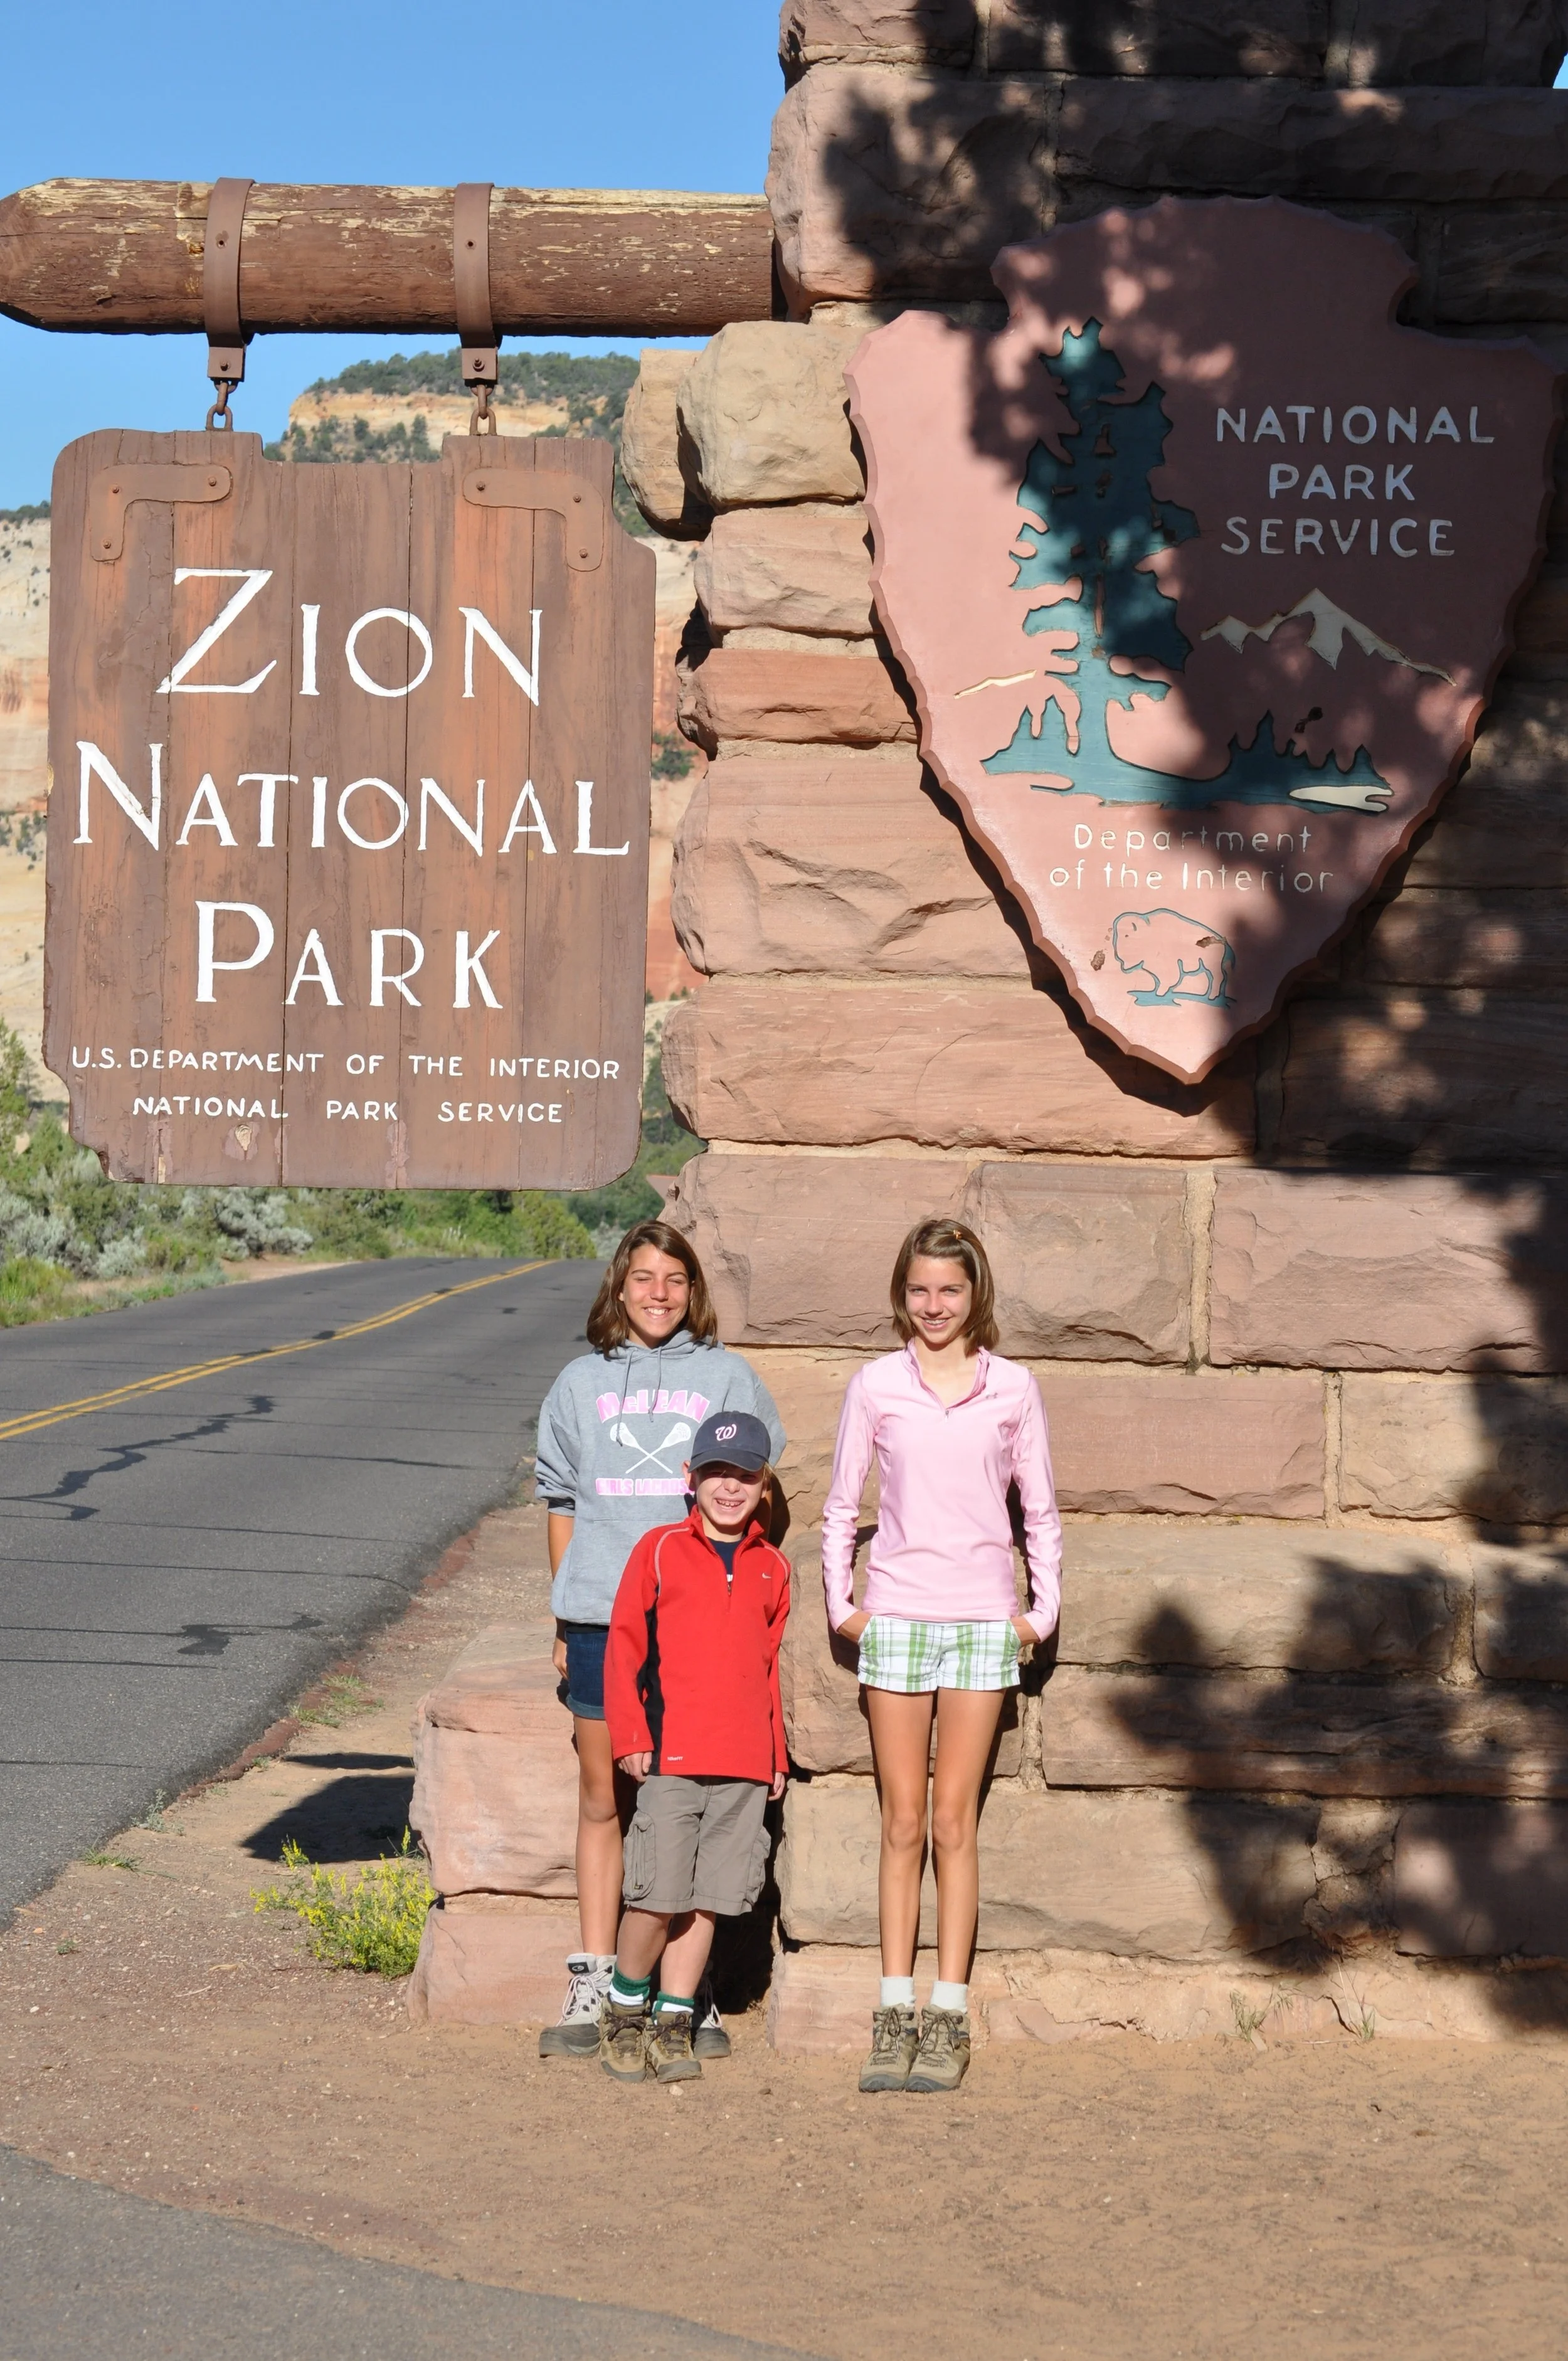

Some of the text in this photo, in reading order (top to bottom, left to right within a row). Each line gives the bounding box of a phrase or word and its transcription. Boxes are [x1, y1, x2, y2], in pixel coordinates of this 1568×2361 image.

[1217, 405, 1495, 444] NATIONAL
[1268, 463, 1415, 501] PARK
[1221, 516, 1455, 558] SERVICE
[156, 567, 543, 706] ZION
[73, 740, 630, 857] NATIONAL
[1074, 824, 1311, 857] Department
[1049, 859, 1333, 893] of the Interior
[194, 899, 503, 1009] PARK
[72, 1046, 620, 1080] U.S. DEPARTMENT OF THE INTERIOR
[132, 1096, 562, 1123] NATIONAL PARK SERVICE
